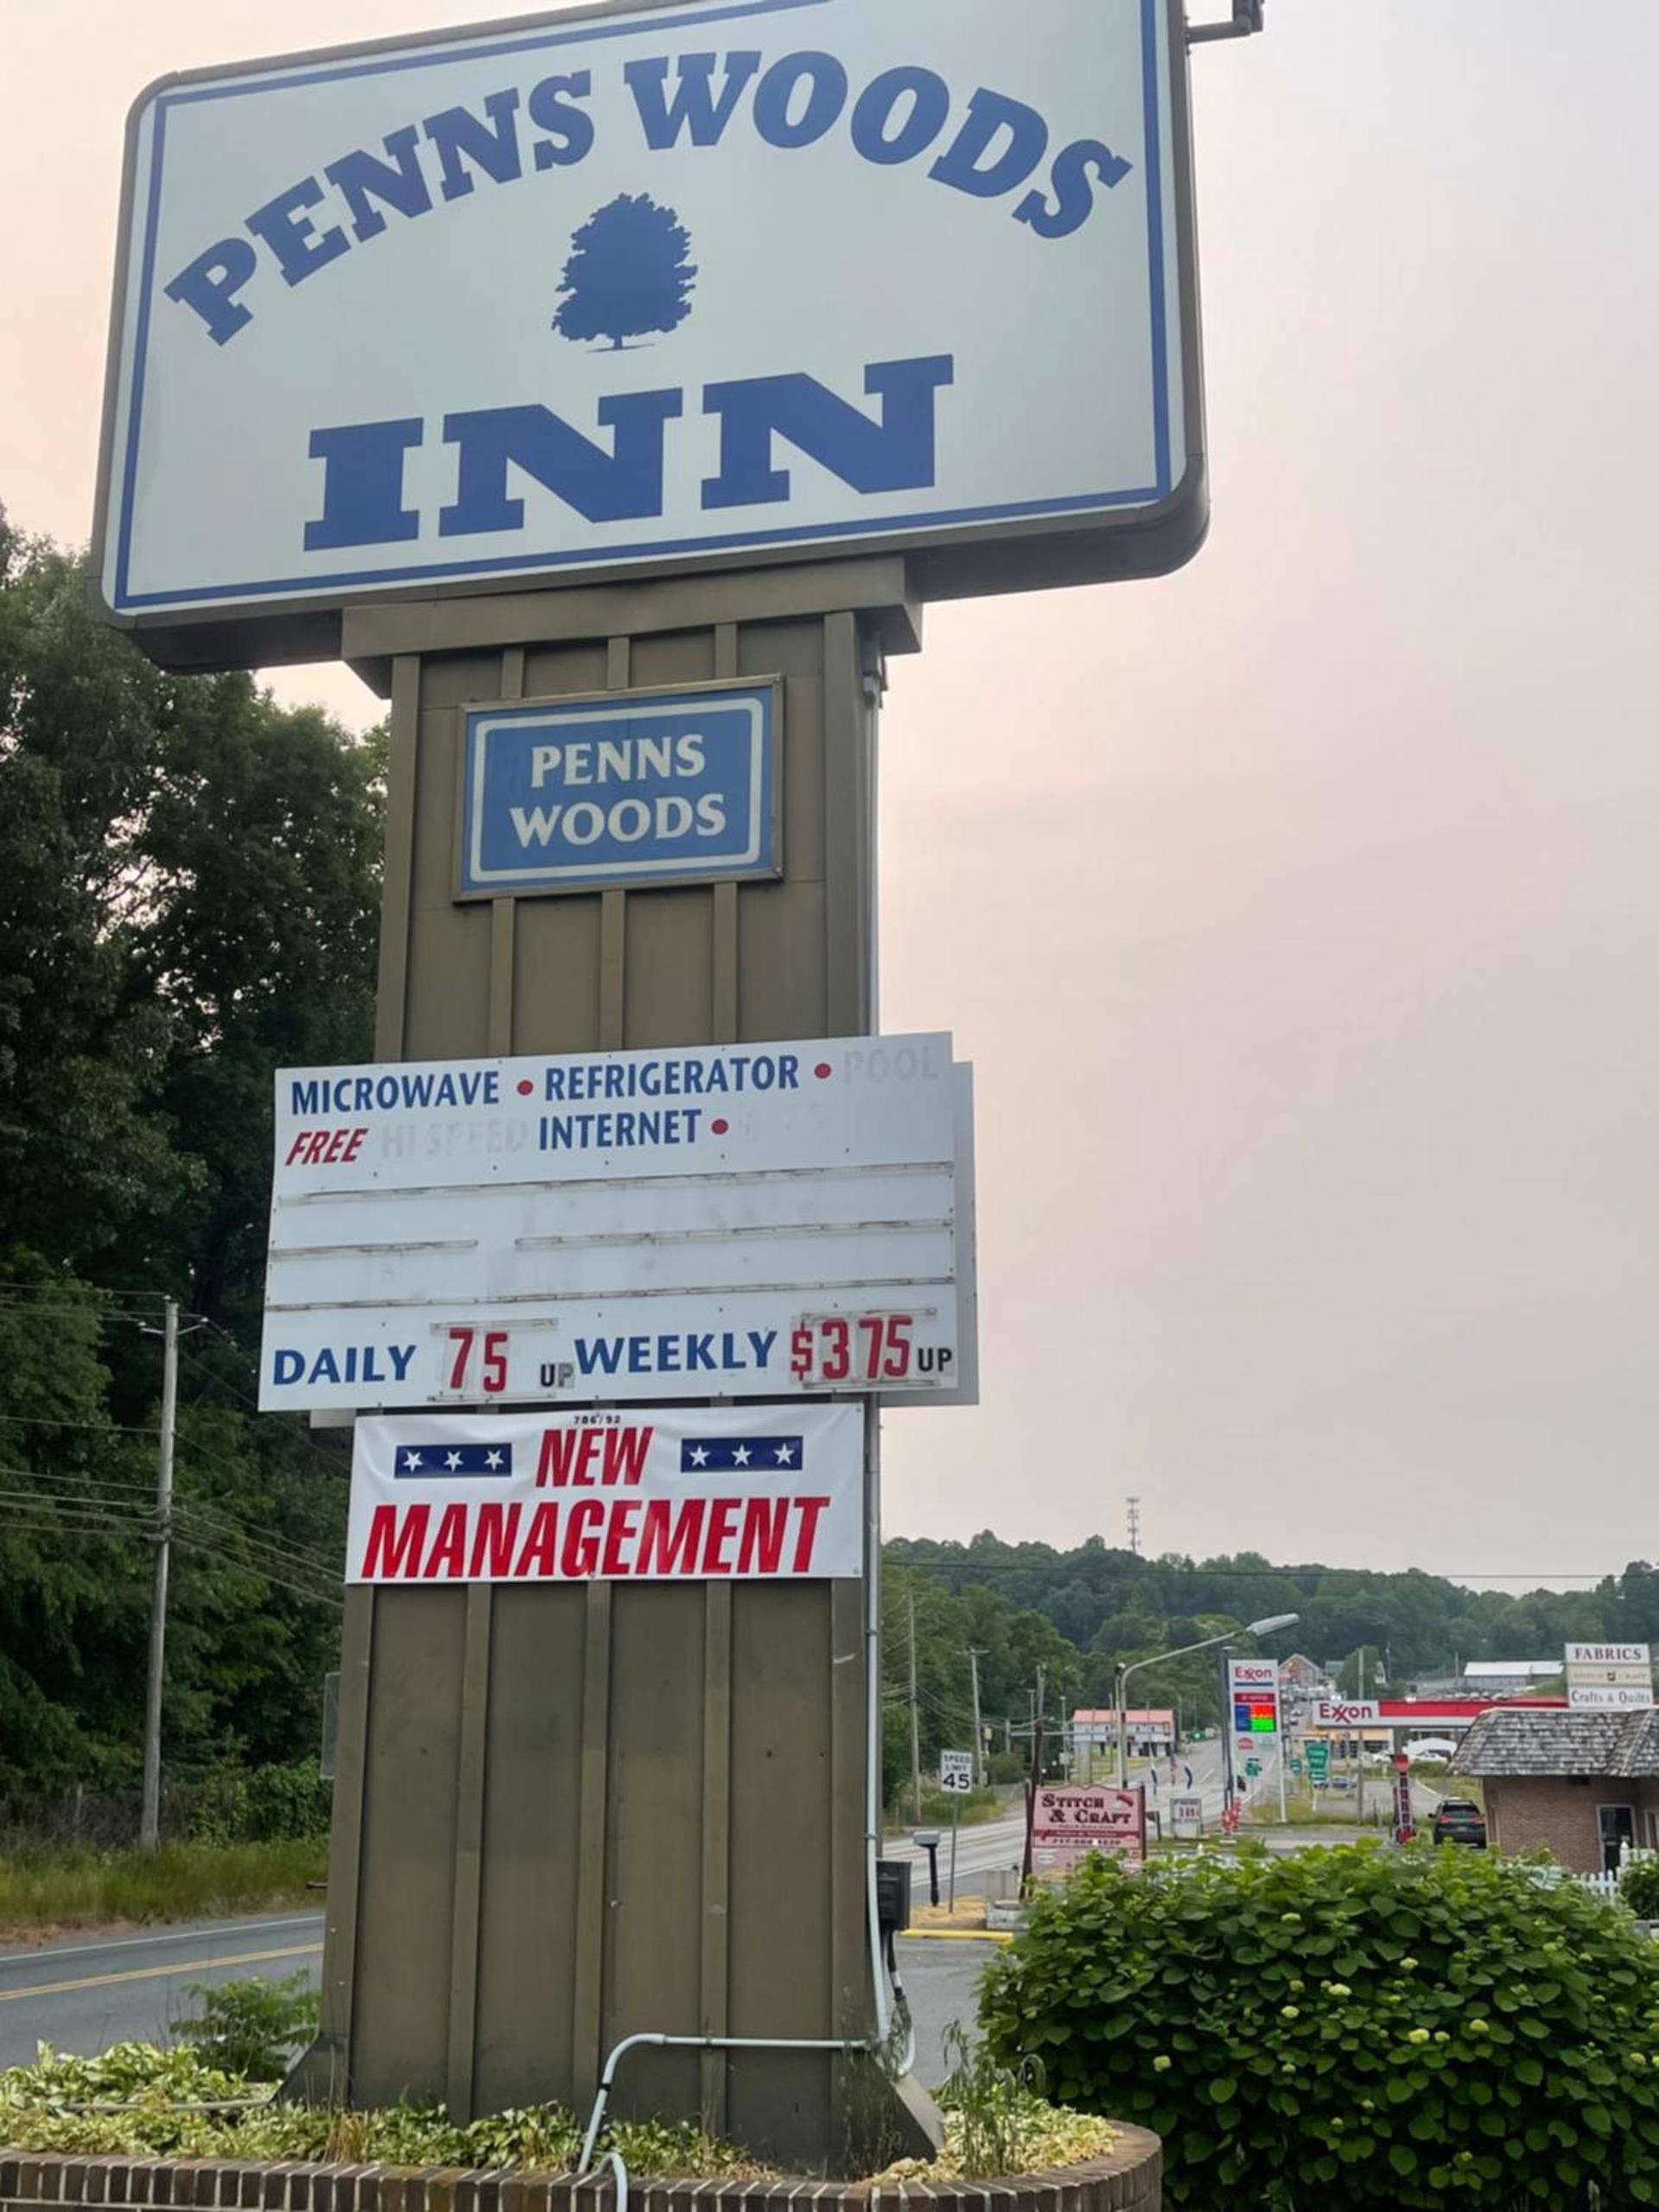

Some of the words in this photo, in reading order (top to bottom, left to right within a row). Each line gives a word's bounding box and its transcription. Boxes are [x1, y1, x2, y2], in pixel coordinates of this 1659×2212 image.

[164, 69, 594, 347] PENNS
[623, 49, 1133, 241] WOODS
[302, 353, 954, 553] INN
[530, 734, 706, 788] PENNS
[508, 792, 727, 849] WOODS
[291, 1071, 499, 1116] MICROWAVE
[544, 1054, 799, 1102] REFRIGERATOR
[844, 1047, 939, 1085] POOL
[284, 1127, 369, 1166] FREE
[539, 1108, 702, 1152] INTERNET
[272, 1344, 416, 1386] DAILY
[449, 1327, 509, 1393] 75
[539, 1362, 575, 1389] UP
[574, 1330, 778, 1376] WEEKLY
[791, 1314, 913, 1381] $375
[918, 1346, 953, 1372] UP
[535, 1426, 654, 1488] NEW
[361, 1496, 830, 1579] MANAGEMENT
[1574, 1646, 1643, 1661] FABRICS
[1234, 1665, 1273, 1681] Exxon
[1319, 1703, 1373, 1724] Exxon
[1570, 1689, 1605, 1703] Crafts
[1618, 1689, 1651, 1705] Quilts
[944, 1753, 970, 1764] SPEED
[944, 1764, 968, 1772] LIMIT
[943, 1772, 970, 1789] 45
[1041, 1792, 1104, 1808] STITCH
[1048, 1808, 1066, 1823] &
[1074, 1808, 1132, 1825] CRAFT
